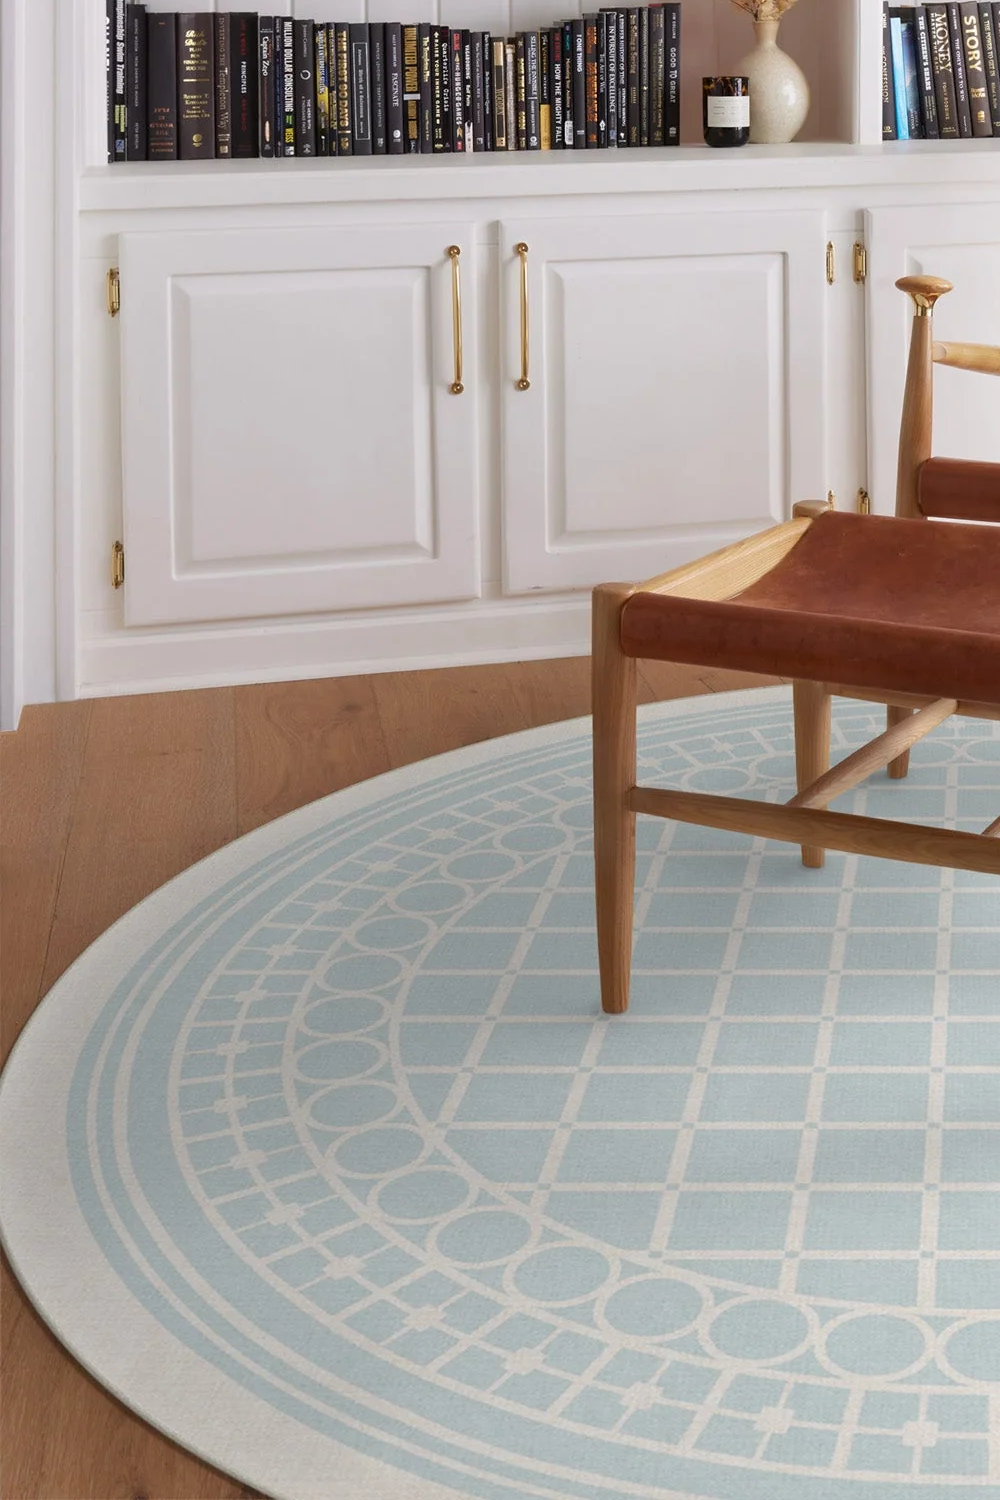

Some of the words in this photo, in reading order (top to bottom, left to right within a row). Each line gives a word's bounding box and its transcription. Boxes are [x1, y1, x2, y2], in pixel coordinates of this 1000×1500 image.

[283, 21, 293, 47] MILLION
[337, 30, 347, 52] THE
[404, 27, 417, 65] UNLIMITED
[934, 12, 951, 73] MONEY
[963, 15, 982, 72] STORY
[116, 41, 124, 63] Swim
[284, 48, 293, 72] DOLLAR
[116, 64, 124, 94] Training
[338, 53, 348, 82] FIRST
[405, 66, 418, 92] POWER
[669, 70, 677, 79] TO
[217, 67, 228, 110] Templeton
[284, 73, 293, 112] CONSULTING
[218, 112, 228, 130] Way
[339, 100, 348, 127] DAYS
[285, 128, 294, 143] WEISS
